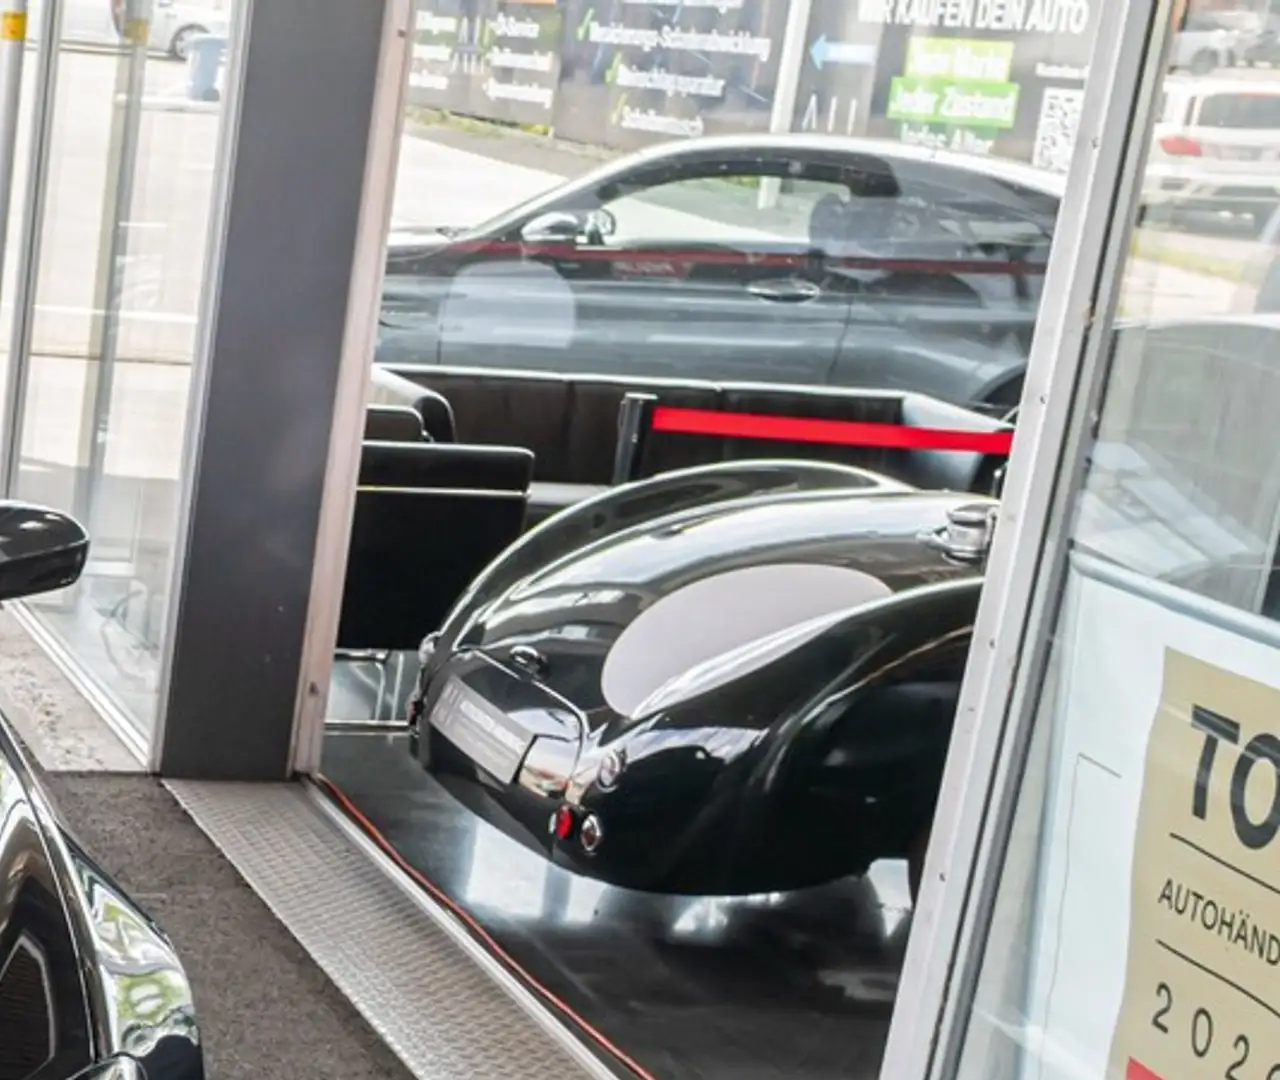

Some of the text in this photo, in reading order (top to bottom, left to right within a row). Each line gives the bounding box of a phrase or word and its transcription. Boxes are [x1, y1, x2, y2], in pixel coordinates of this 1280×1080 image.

[1025, 0, 1089, 33] AUTO
[1190, 703, 1280, 850] TO
[1157, 877, 1280, 967] AUTOHÄND
